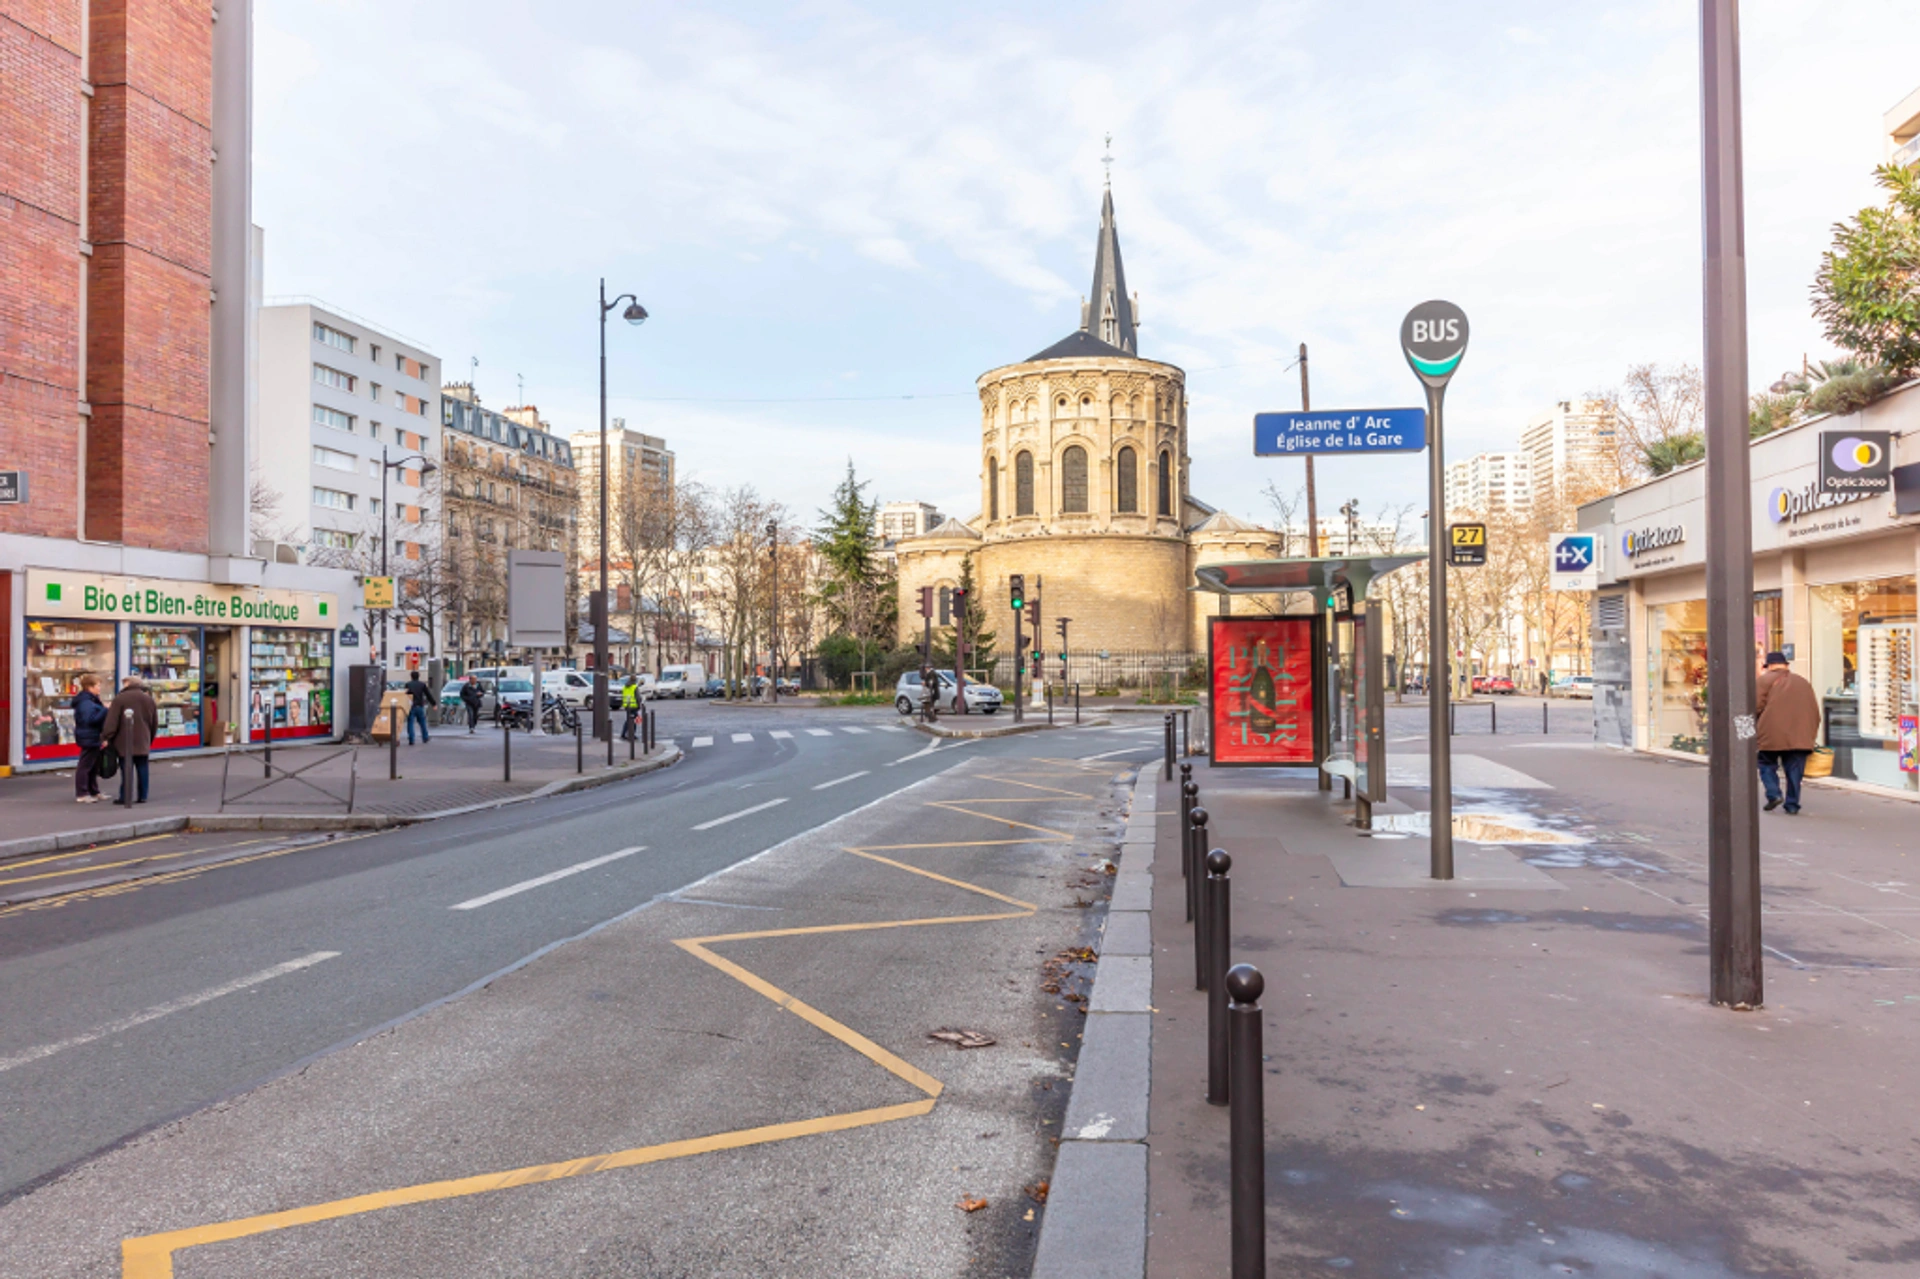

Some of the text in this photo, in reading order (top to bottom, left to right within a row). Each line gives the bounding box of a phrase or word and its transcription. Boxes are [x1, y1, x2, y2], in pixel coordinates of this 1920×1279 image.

[1411, 318, 1460, 343] BUS
[1288, 418, 1341, 431] Jeanne
[1364, 416, 1391, 429] Arc
[1276, 432, 1403, 451] Église de la Gare
[1456, 528, 1479, 543] 27
[84, 585, 299, 623] Bio et Bien-être Boutique
